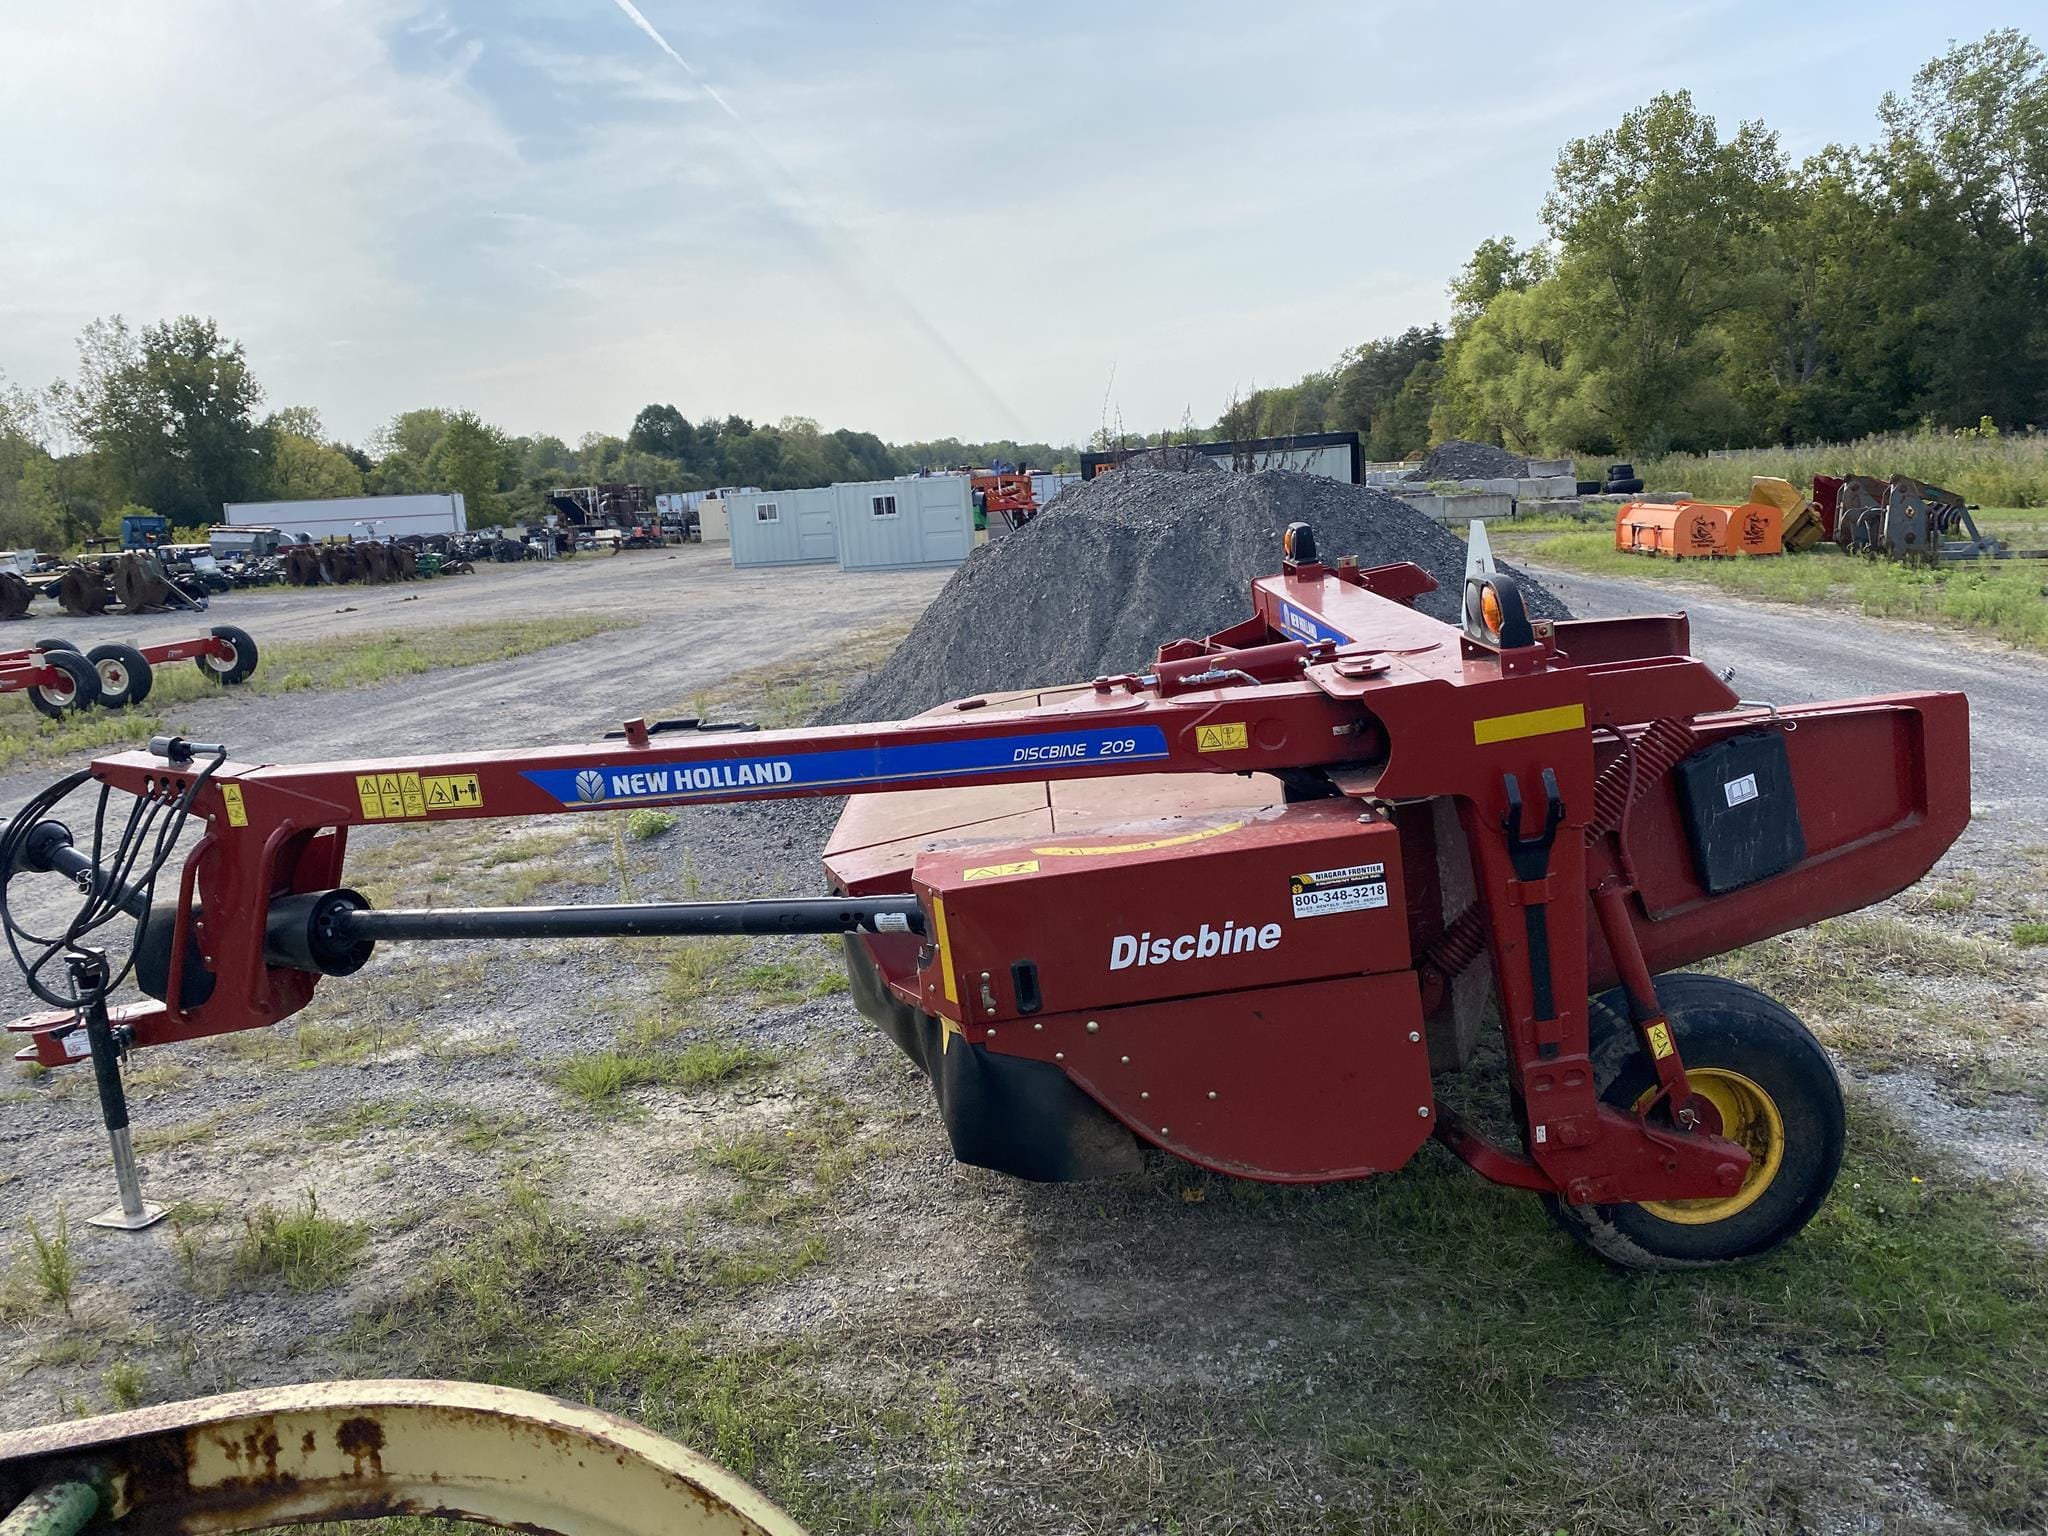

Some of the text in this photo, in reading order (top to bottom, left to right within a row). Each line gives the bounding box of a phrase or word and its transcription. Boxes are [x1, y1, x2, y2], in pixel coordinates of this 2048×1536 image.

[1013, 739, 1136, 761] DISCBINE 209
[611, 761, 792, 796] NEW HOLLAND
[1315, 865, 1382, 880] NIAGARA FRONTIER
[1295, 885, 1385, 906] 800-348-3218
[1109, 921, 1282, 971] Discbine
